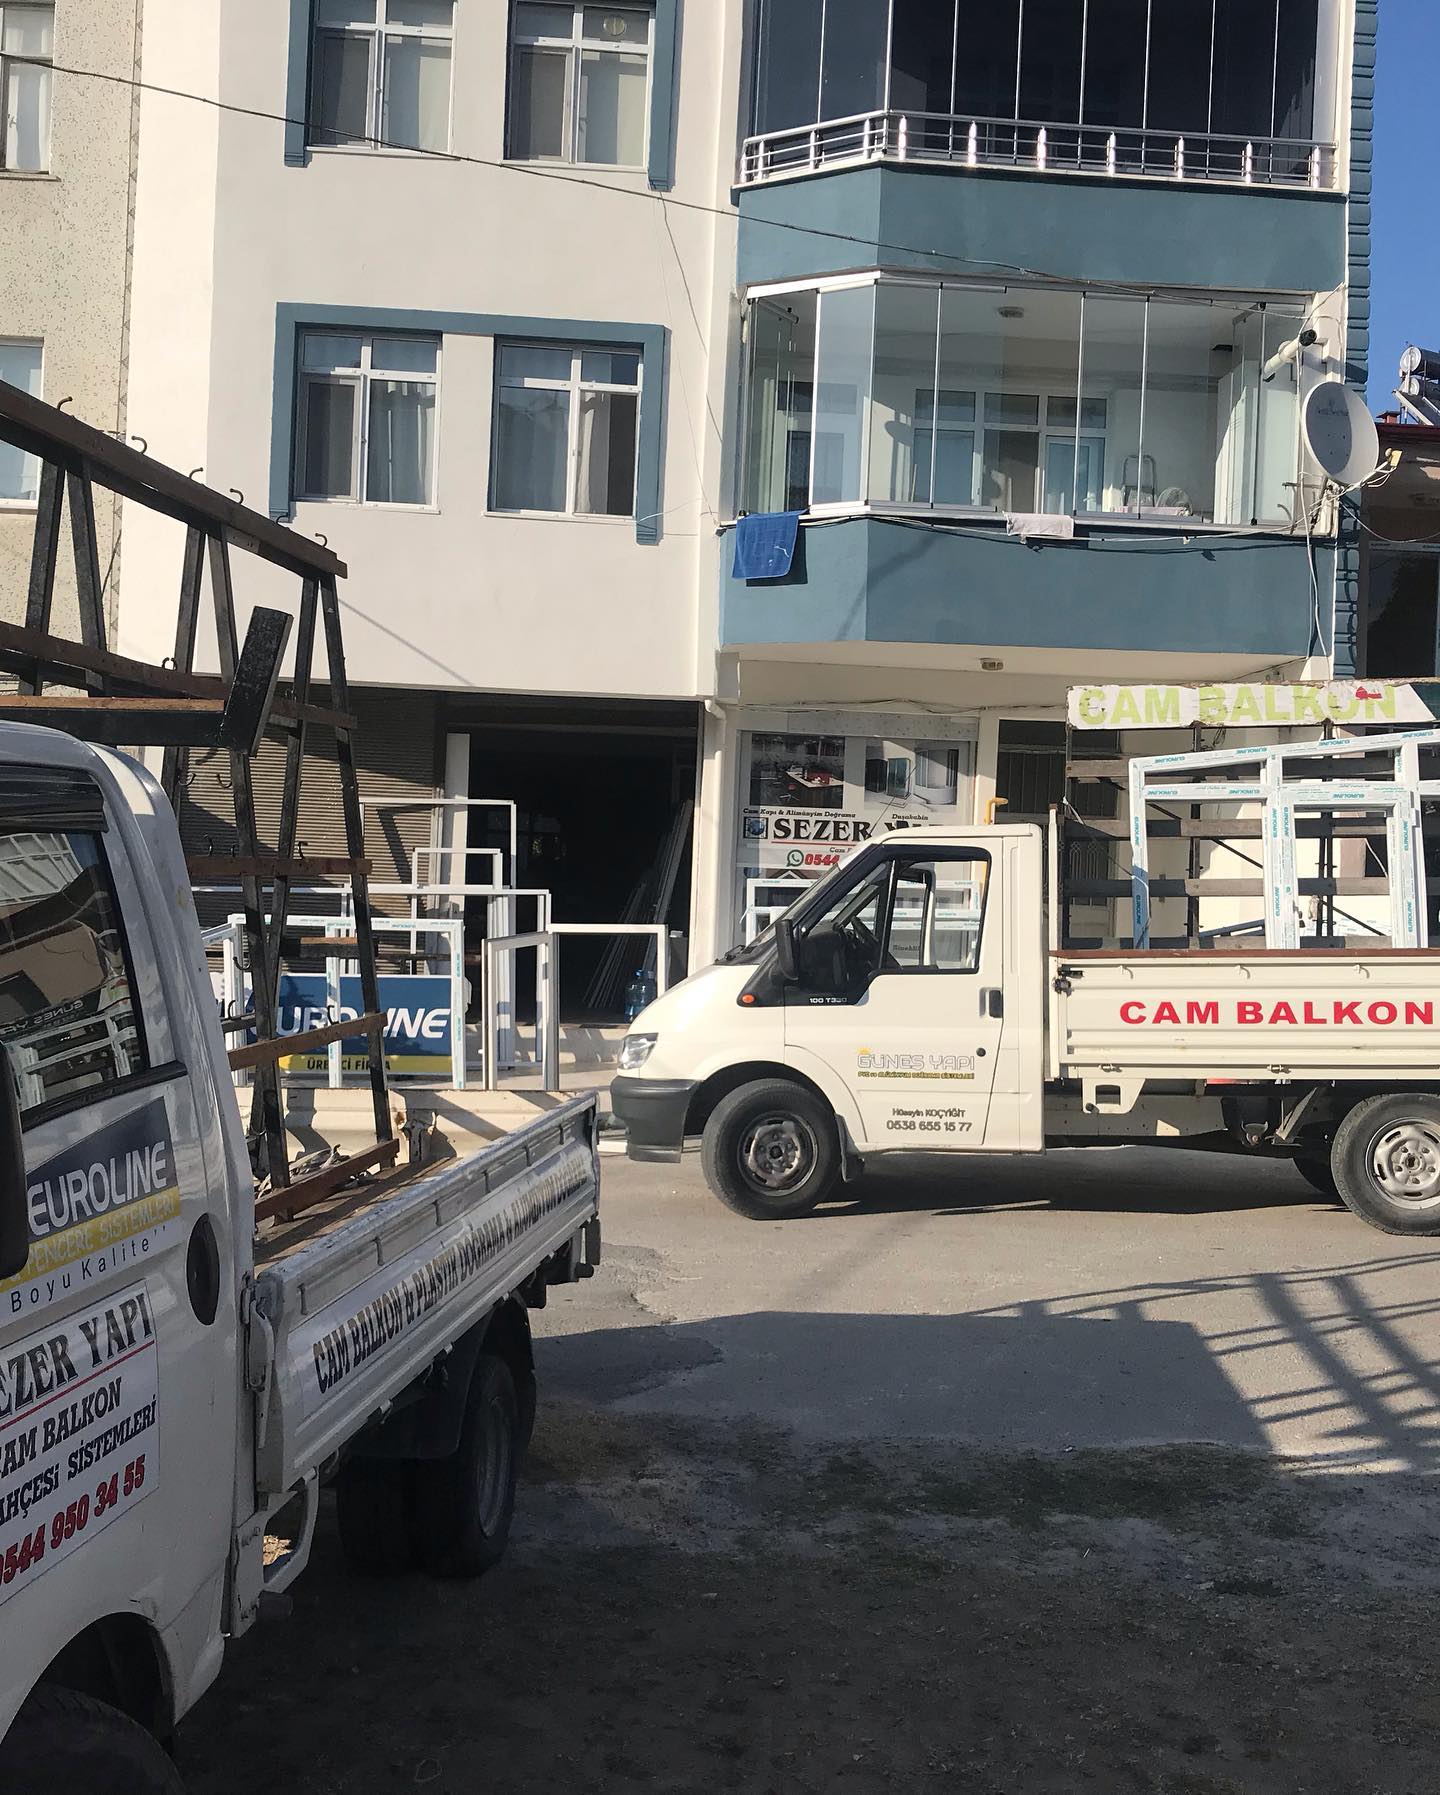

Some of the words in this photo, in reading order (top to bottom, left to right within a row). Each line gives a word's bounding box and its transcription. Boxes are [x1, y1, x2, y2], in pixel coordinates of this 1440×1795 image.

[1078, 686, 1181, 725] CAM
[1199, 684, 1399, 723] BALKON
[773, 817, 872, 842] SEZER
[1119, 1001, 1220, 1025] CAM
[1236, 1001, 1434, 1025] BALKON
[307, 1056, 351, 1071] ÜRECİ
[355, 1057, 391, 1071] FİA
[928, 1054, 975, 1071] YAPI
[886, 1120, 917, 1130] 0538
[918, 1120, 942, 1131] 655
[943, 1121, 956, 1131] 15
[958, 1122, 973, 1132] 77
[27, 1140, 168, 1237] EUROLINE
[11, 1272, 71, 1313] Boyu
[78, 1292, 153, 1368] YAPI
[312, 1325, 351, 1394] CAM
[346, 1285, 404, 1369] BALKON
[401, 1279, 415, 1325] &
[0, 1425, 38, 1479] AM
[42, 1376, 123, 1454] BALKON
[68, 1393, 157, 1481] SİSTEMLERİ
[50, 1493, 90, 1550] 950
[94, 1471, 119, 1517] 34
[123, 1453, 146, 1497] 55
